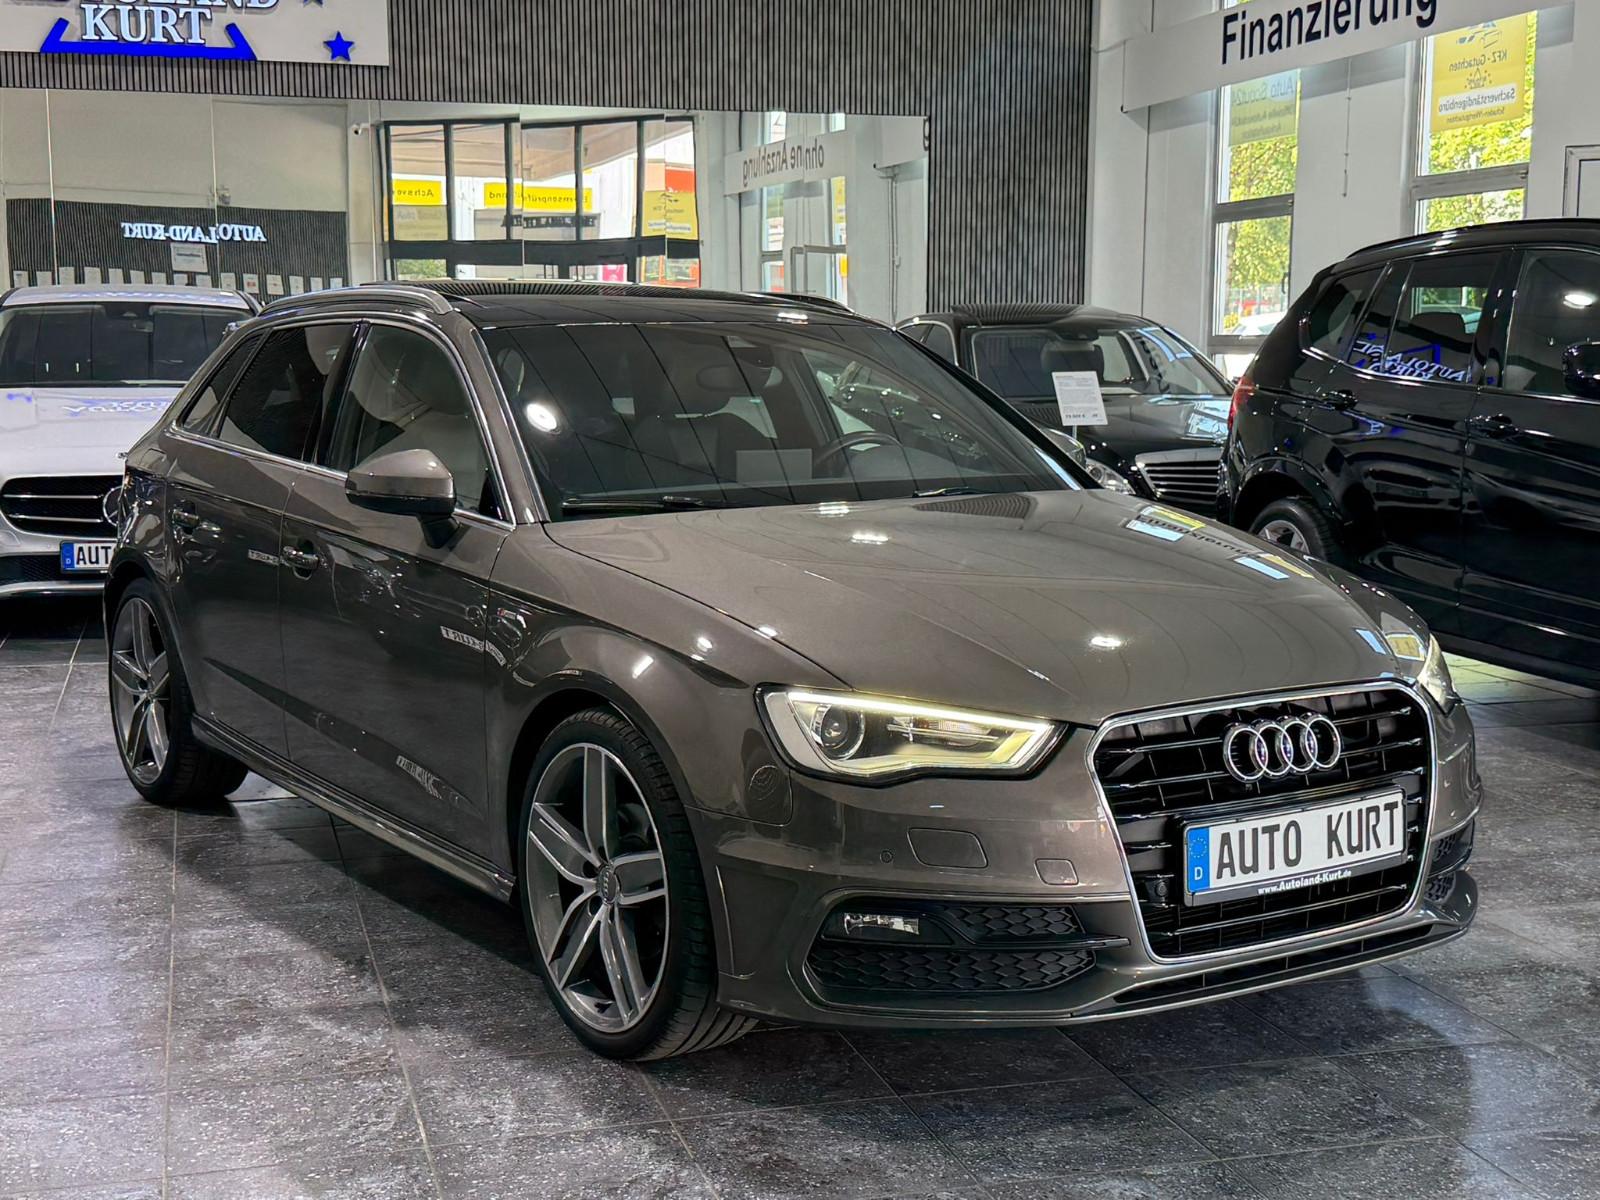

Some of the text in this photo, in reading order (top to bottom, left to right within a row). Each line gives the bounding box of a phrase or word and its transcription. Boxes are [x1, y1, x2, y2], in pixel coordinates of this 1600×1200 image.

[80, 4, 212, 44] KURT
[1194, 801, 1399, 881] D AUTO KURT
[1257, 869, 1352, 895] www.Autoland-Kurt.de
